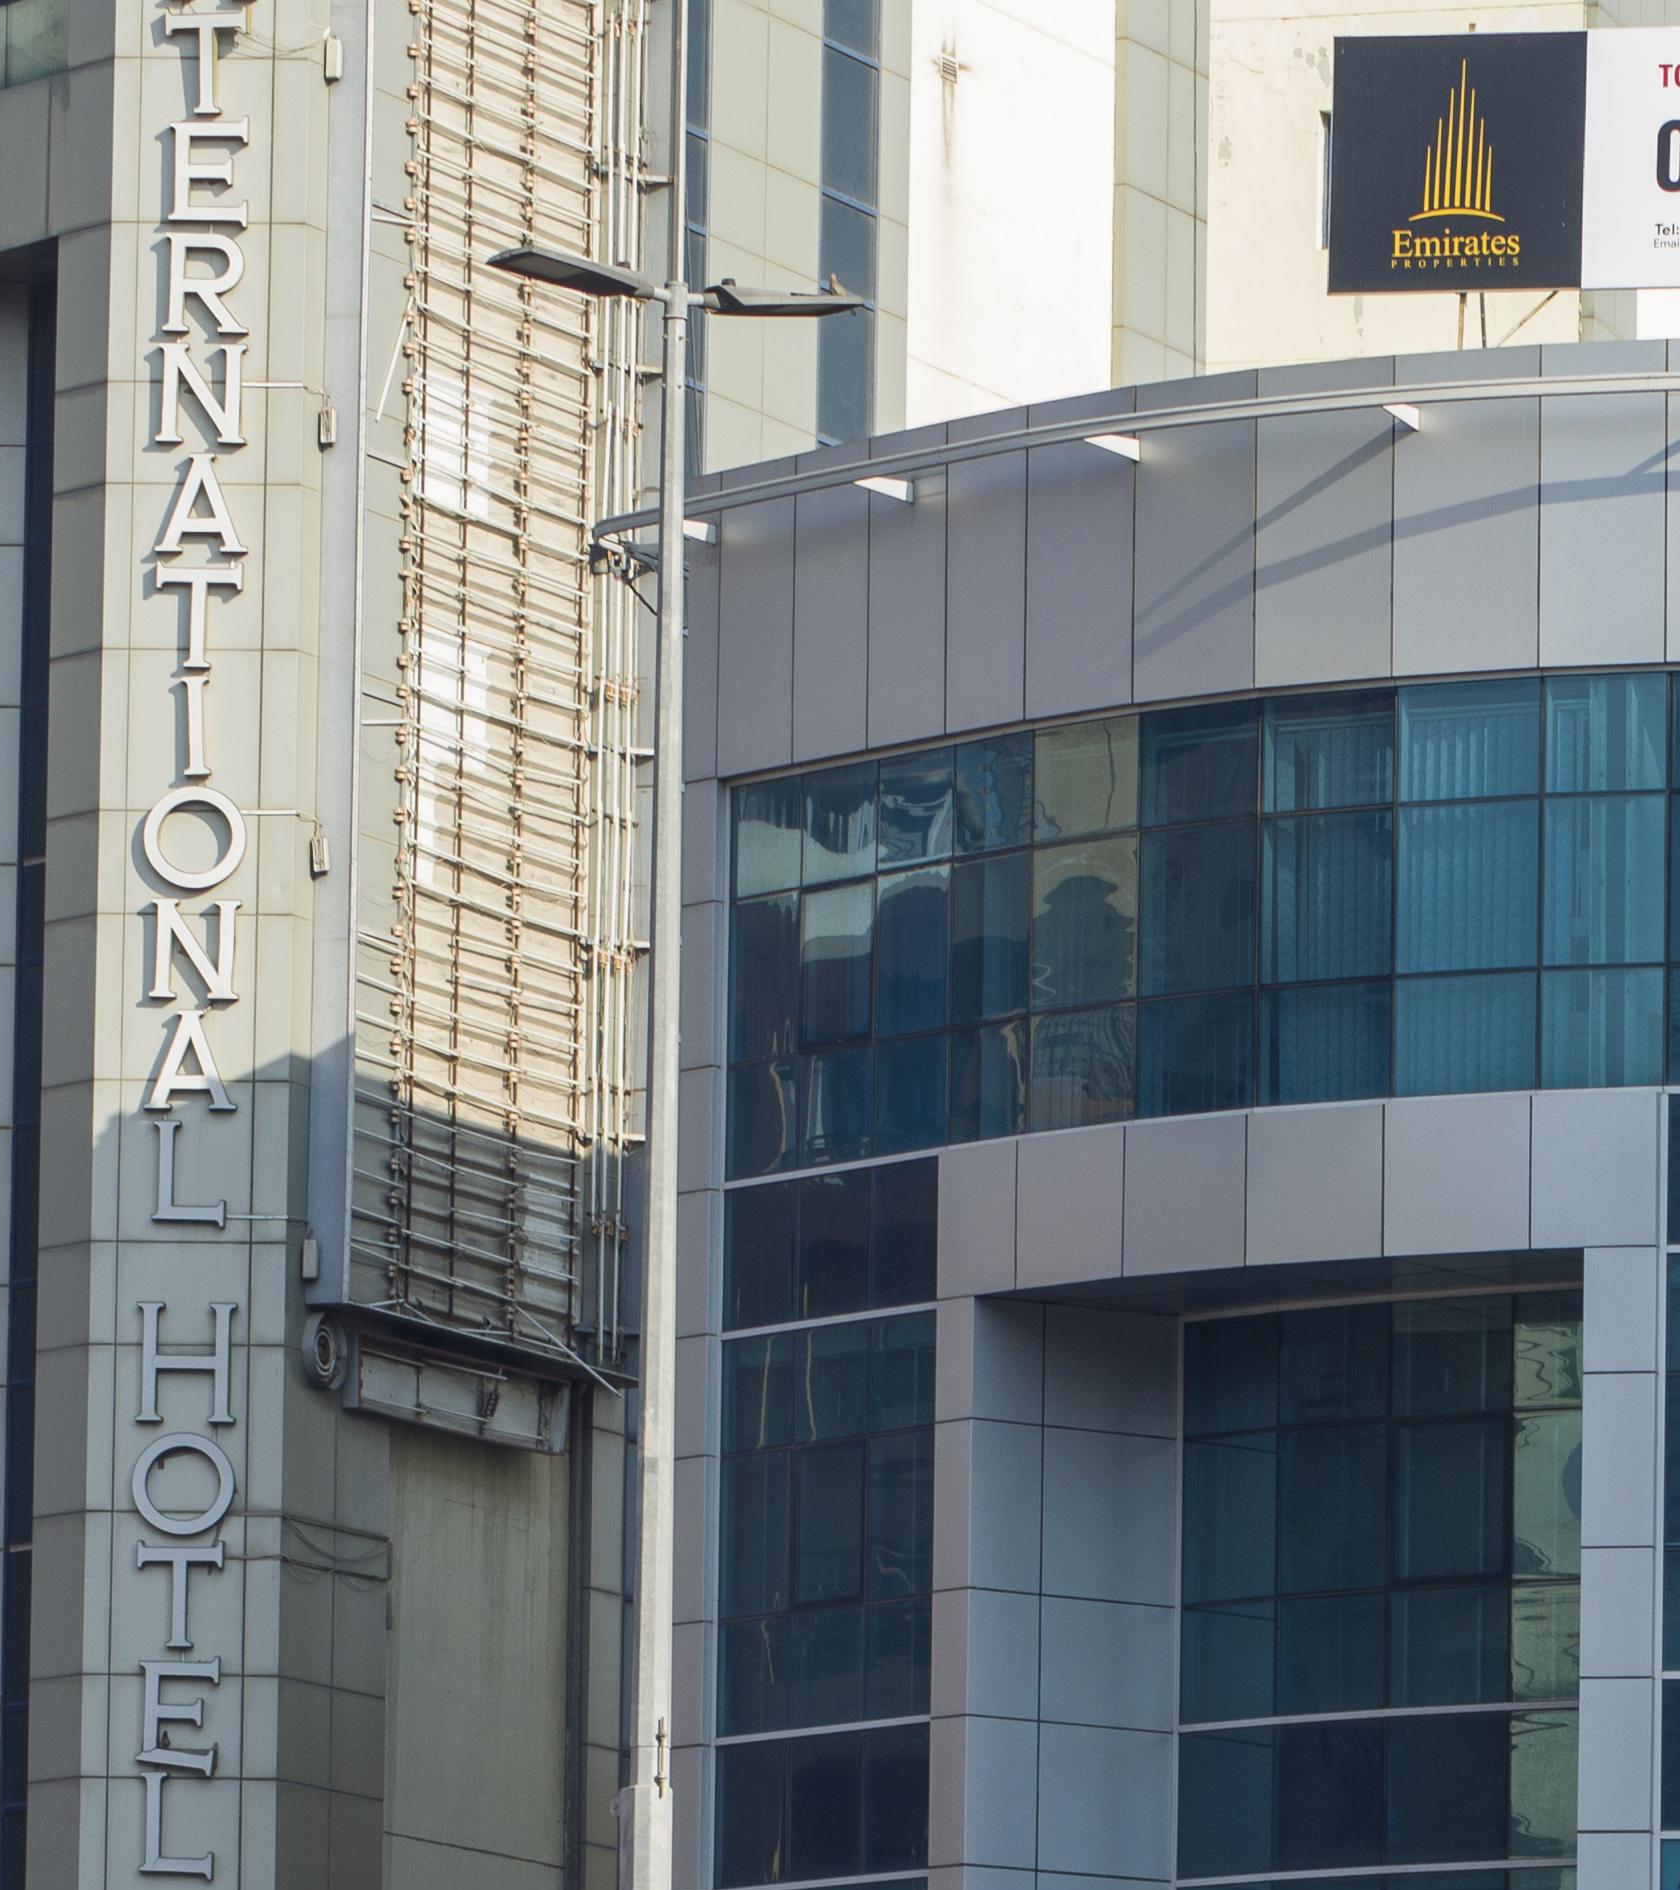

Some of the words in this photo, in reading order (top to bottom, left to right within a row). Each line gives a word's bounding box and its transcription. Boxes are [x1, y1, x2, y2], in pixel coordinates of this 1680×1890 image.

[1392, 228, 1520, 258] Emirates
[1655, 223, 1680, 236] Tel:
[1391, 257, 1520, 268] PROPERTIES
[142, 0, 250, 1228] TERNATIONAL
[131, 1302, 238, 1882] HOTEL
